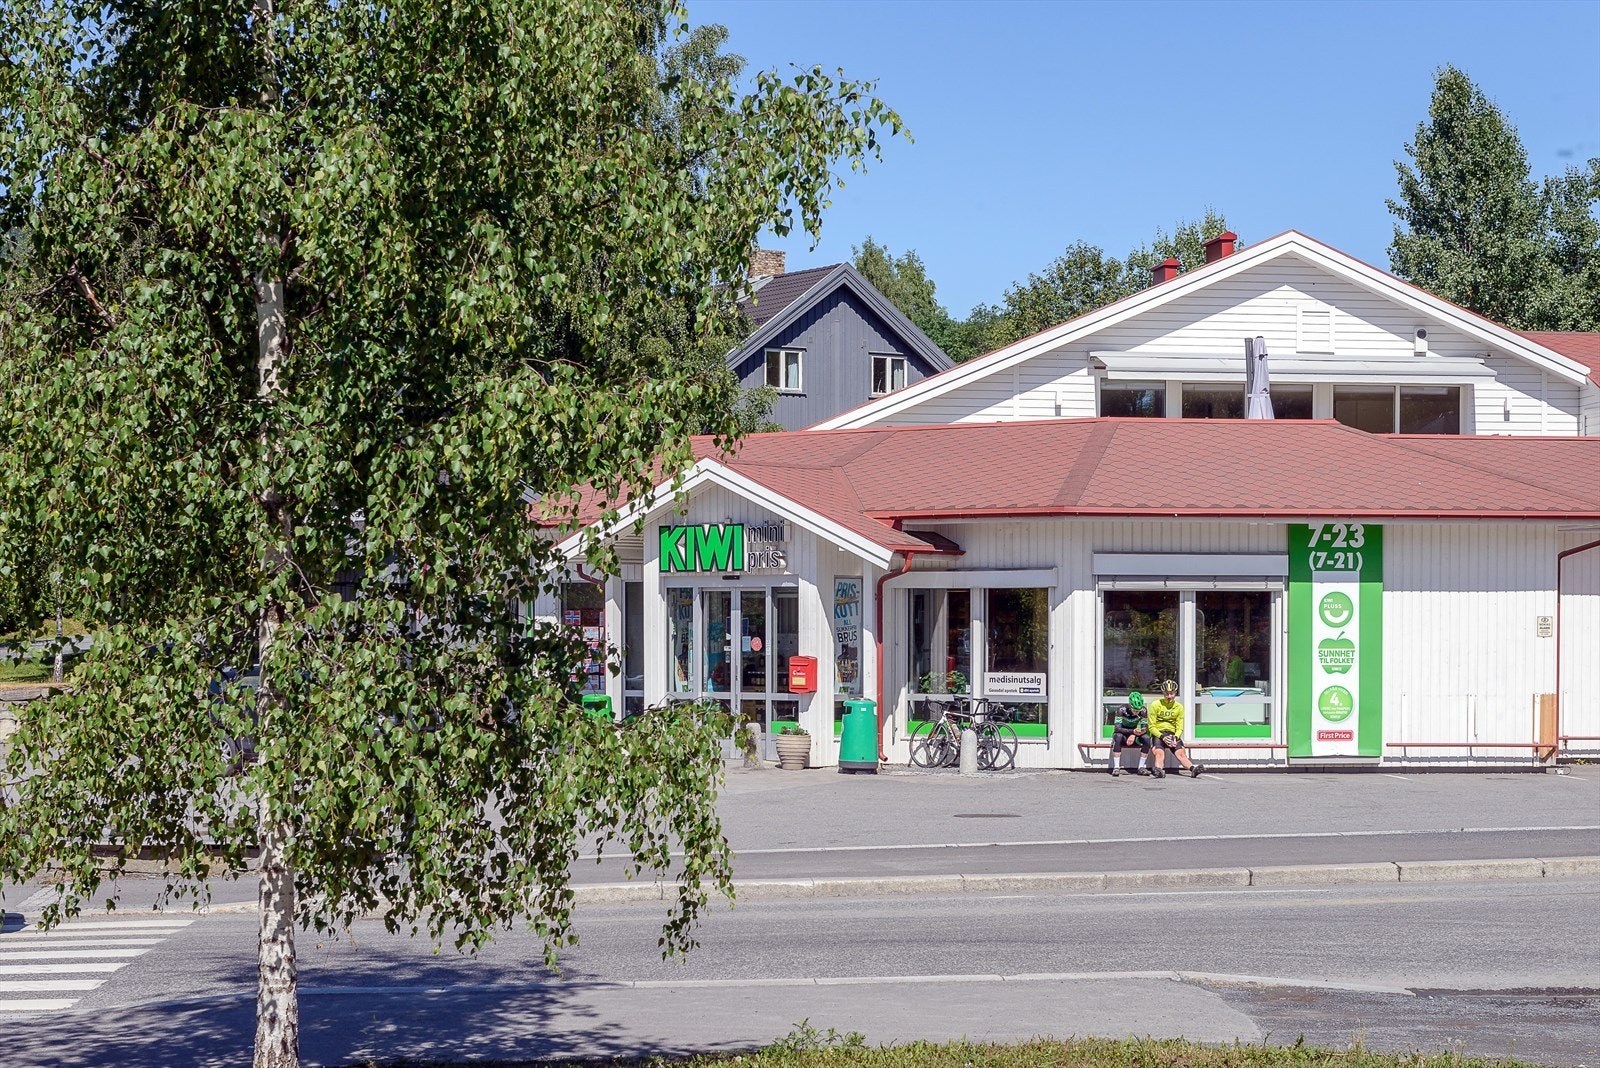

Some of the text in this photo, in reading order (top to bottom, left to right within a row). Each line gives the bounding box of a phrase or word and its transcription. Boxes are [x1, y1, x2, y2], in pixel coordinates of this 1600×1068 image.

[747, 520, 785, 542] mini
[1307, 521, 1365, 549] 7-23
[658, 524, 744, 572] KIWI
[747, 546, 781, 573] pris
[1308, 551, 1363, 571] (7-21)
[835, 581, 861, 598] PRIS-
[834, 600, 860, 619] KUTT
[837, 630, 858, 643] BRUS
[1318, 650, 1356, 658] SUNNHET
[989, 675, 1042, 686] medisinutsalg
[1329, 692, 1344, 706] 4.
